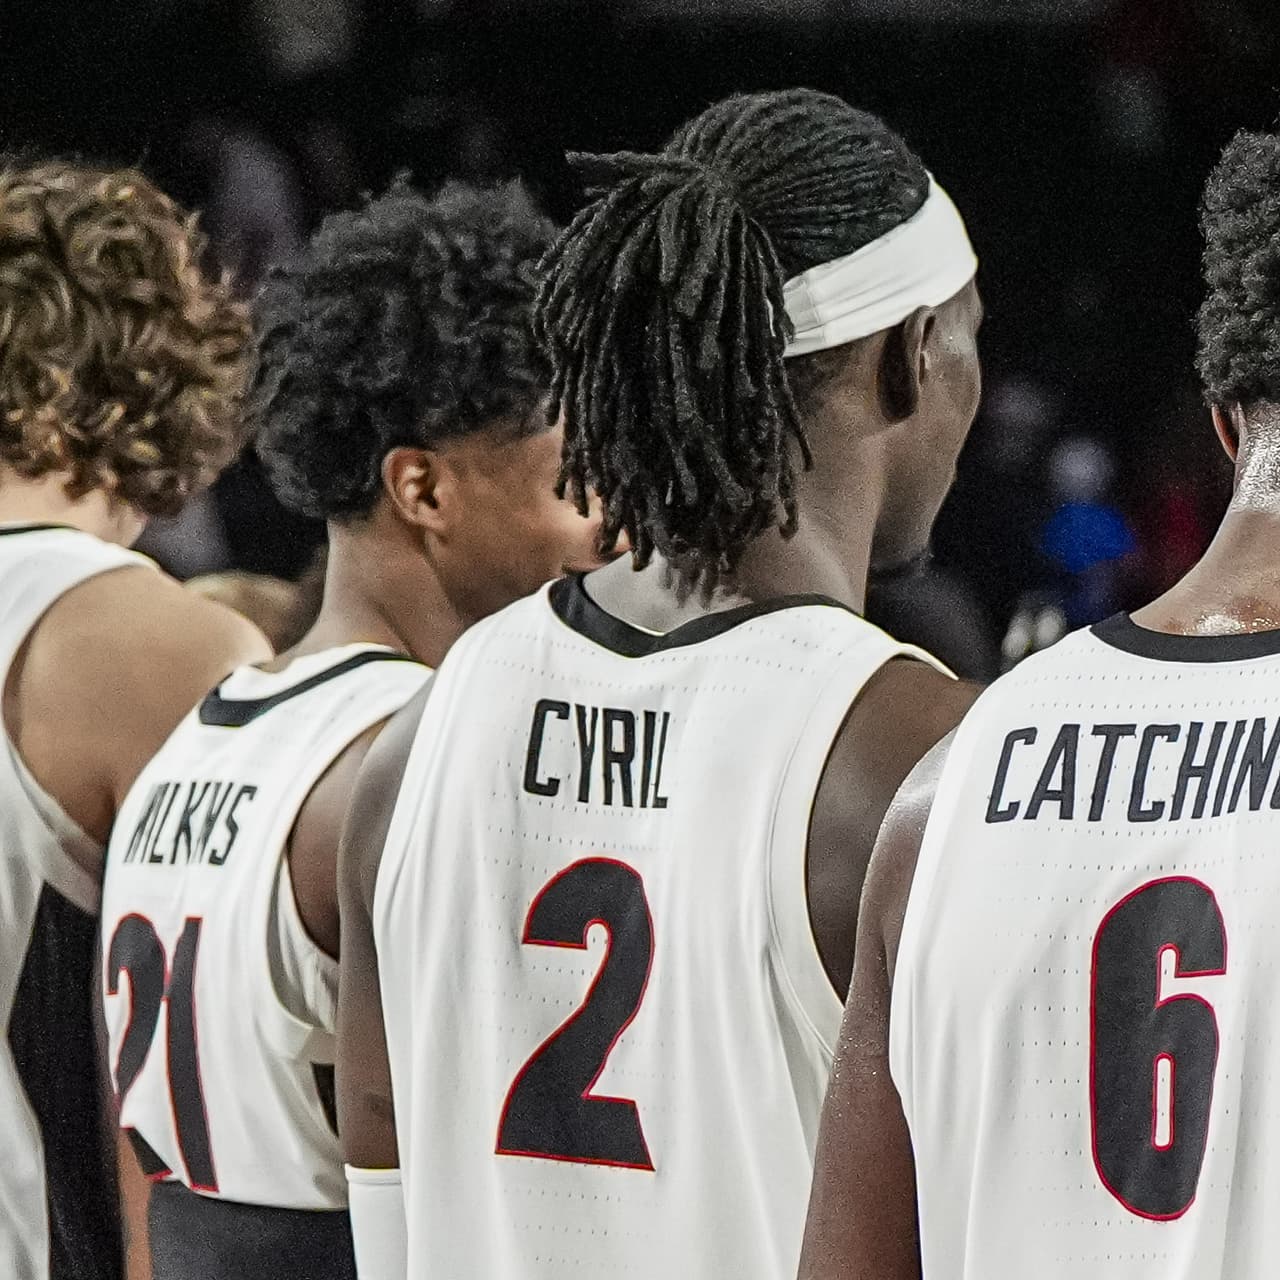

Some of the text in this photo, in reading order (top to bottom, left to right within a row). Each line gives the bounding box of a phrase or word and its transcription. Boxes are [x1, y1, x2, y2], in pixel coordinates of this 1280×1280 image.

[524, 698, 670, 808] CYRIL
[105, 912, 219, 1192] 21
[495, 856, 656, 1172] 2
[1090, 875, 1227, 1221] 6
